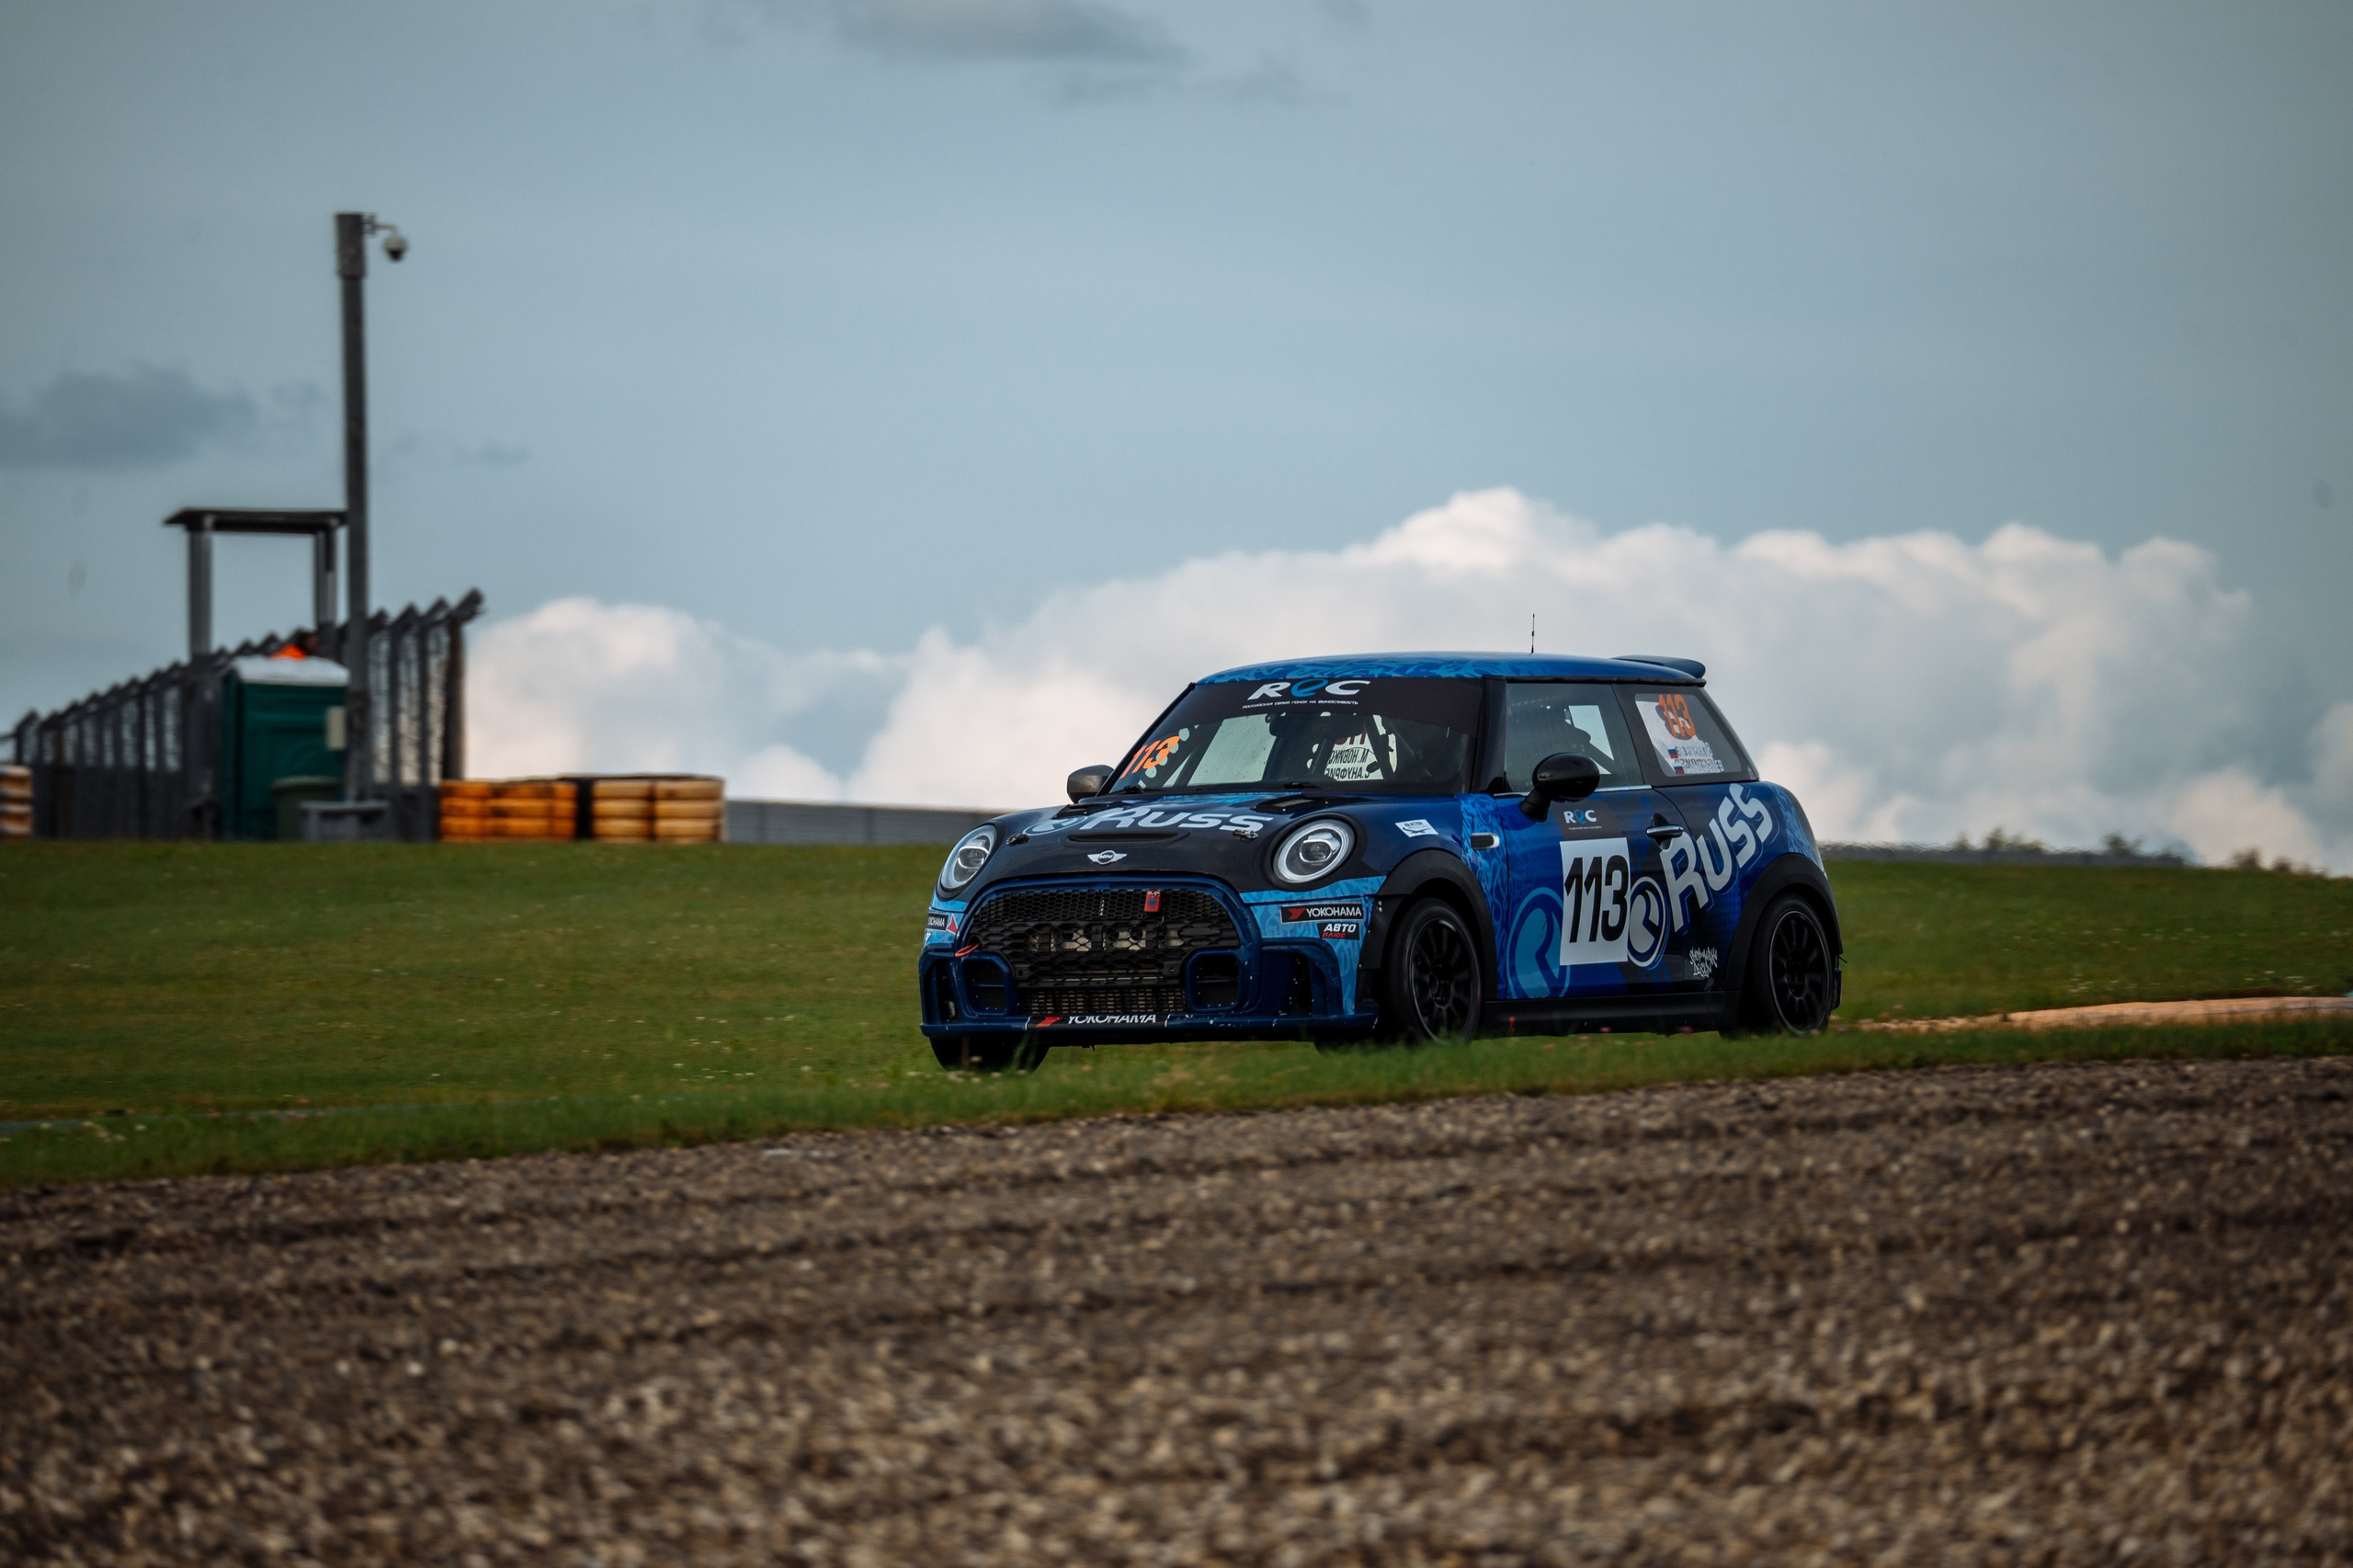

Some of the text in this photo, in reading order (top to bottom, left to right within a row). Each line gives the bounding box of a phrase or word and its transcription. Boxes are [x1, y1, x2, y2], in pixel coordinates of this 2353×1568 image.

[1658, 694, 1697, 738] 113
[1120, 735, 1181, 779] 113
[1306, 906, 1362, 917] YOKOHAMA
[1564, 855, 1630, 943] 113
[1324, 923, 1357, 933] АВТО
[1068, 1015, 1156, 1024] YOKOHAMA
